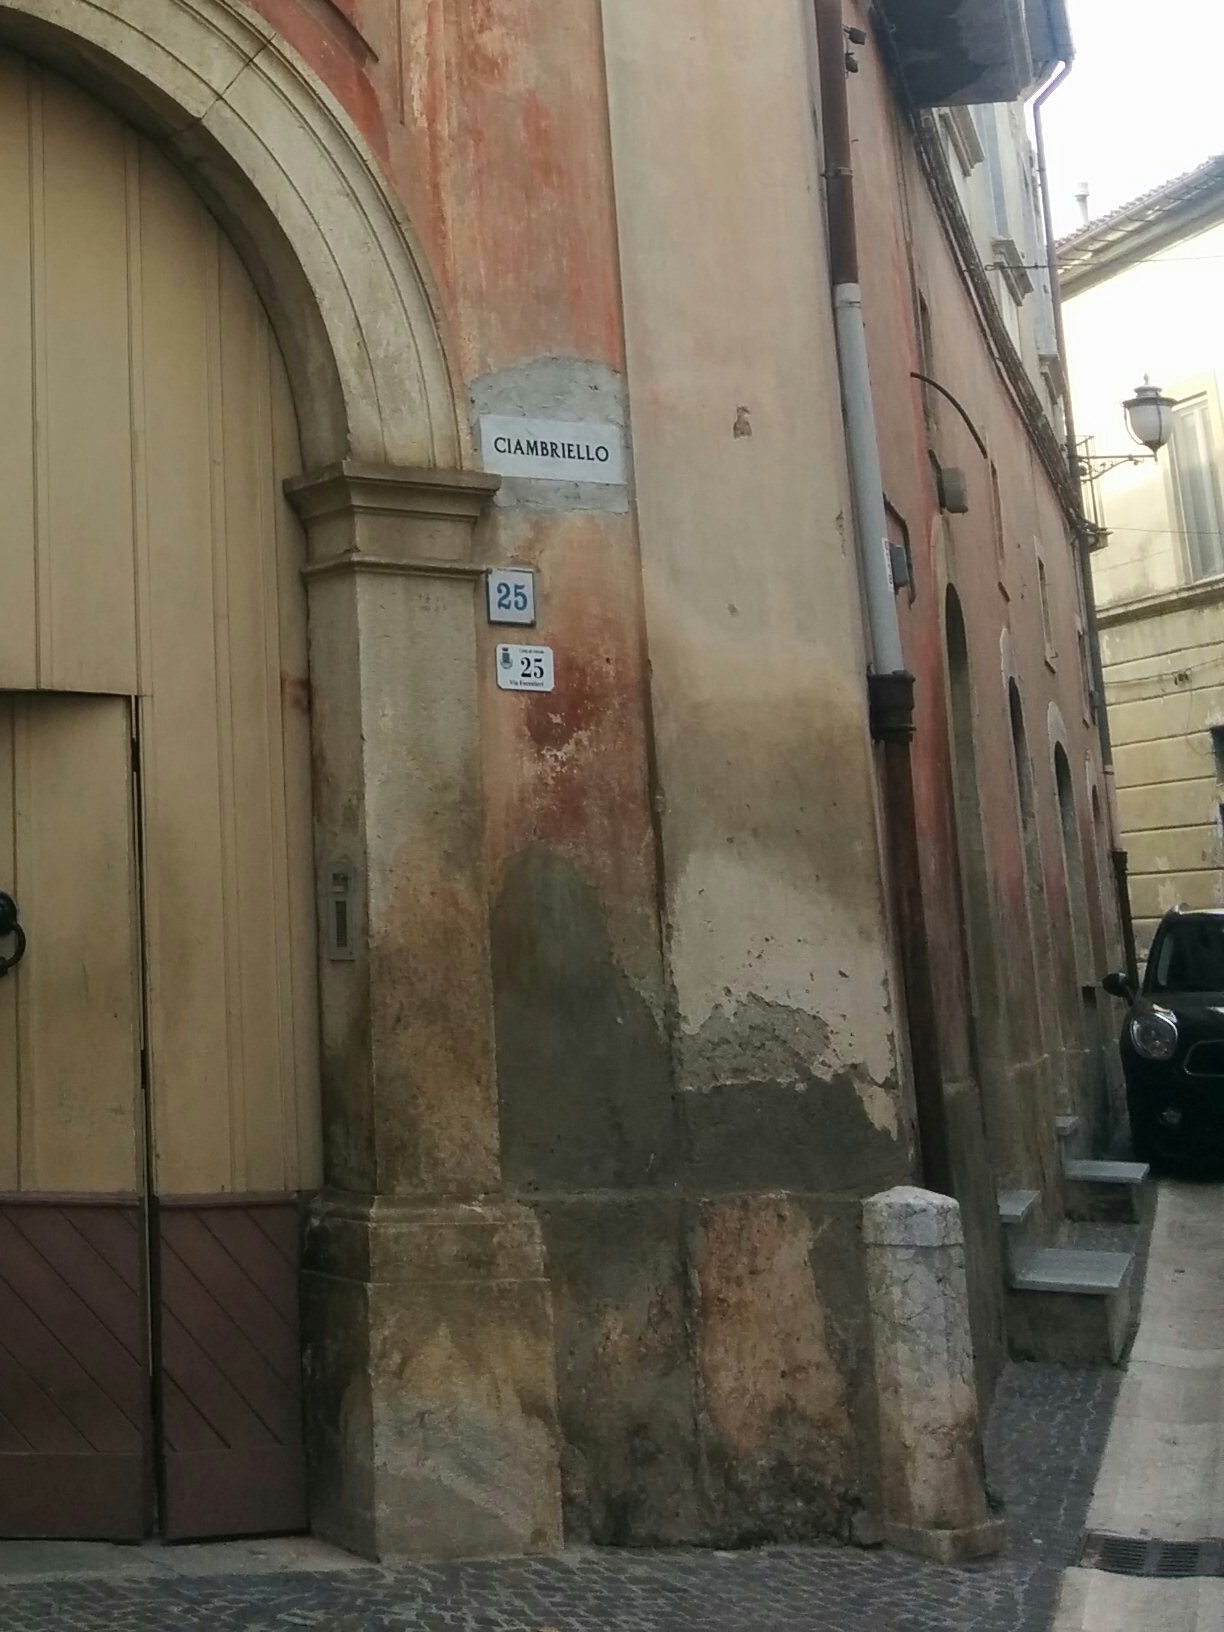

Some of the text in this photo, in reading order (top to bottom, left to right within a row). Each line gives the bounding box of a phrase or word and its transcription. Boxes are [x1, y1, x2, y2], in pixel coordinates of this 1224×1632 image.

[494, 437, 609, 462] CIAMBRIELLO
[497, 582, 528, 610] 25
[521, 657, 545, 679] 25
